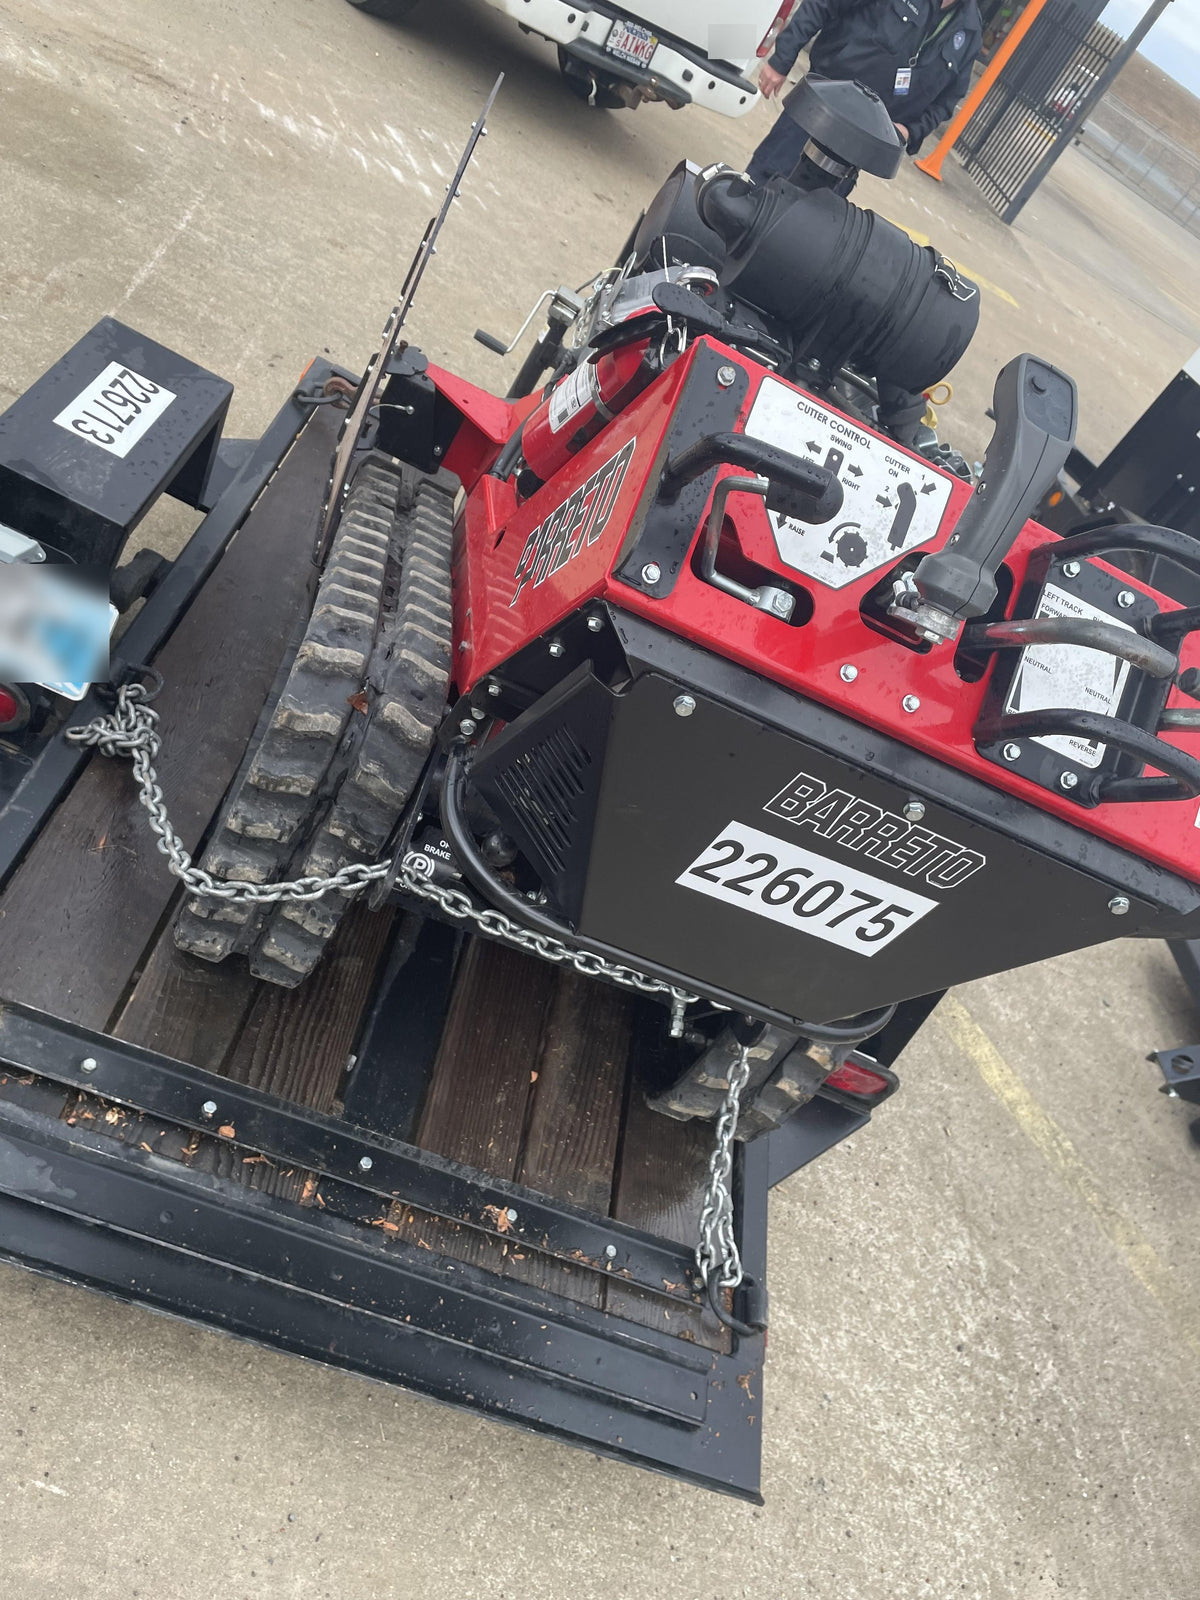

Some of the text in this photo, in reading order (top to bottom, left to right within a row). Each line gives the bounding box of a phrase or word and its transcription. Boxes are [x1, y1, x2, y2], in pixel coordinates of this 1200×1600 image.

[620, 34, 654, 59] AIWKG
[71, 368, 160, 445] 226713
[796, 401, 871, 449] CUTTER CONTROL
[830, 434, 853, 451] SWING
[884, 455, 911, 474] CUTTER
[888, 468, 899, 478] ON
[841, 477, 861, 491] RIGHT
[788, 523, 806, 537] RAISE
[1060, 598, 1084, 615] TRACK
[1024, 656, 1053, 674] NEUTRAL
[1084, 687, 1112, 705] NEUTRAL
[1068, 739, 1098, 757] REVERSE
[762, 772, 986, 889] BARRETO
[424, 844, 451, 860] BRAKE
[688, 839, 914, 942] 226075
